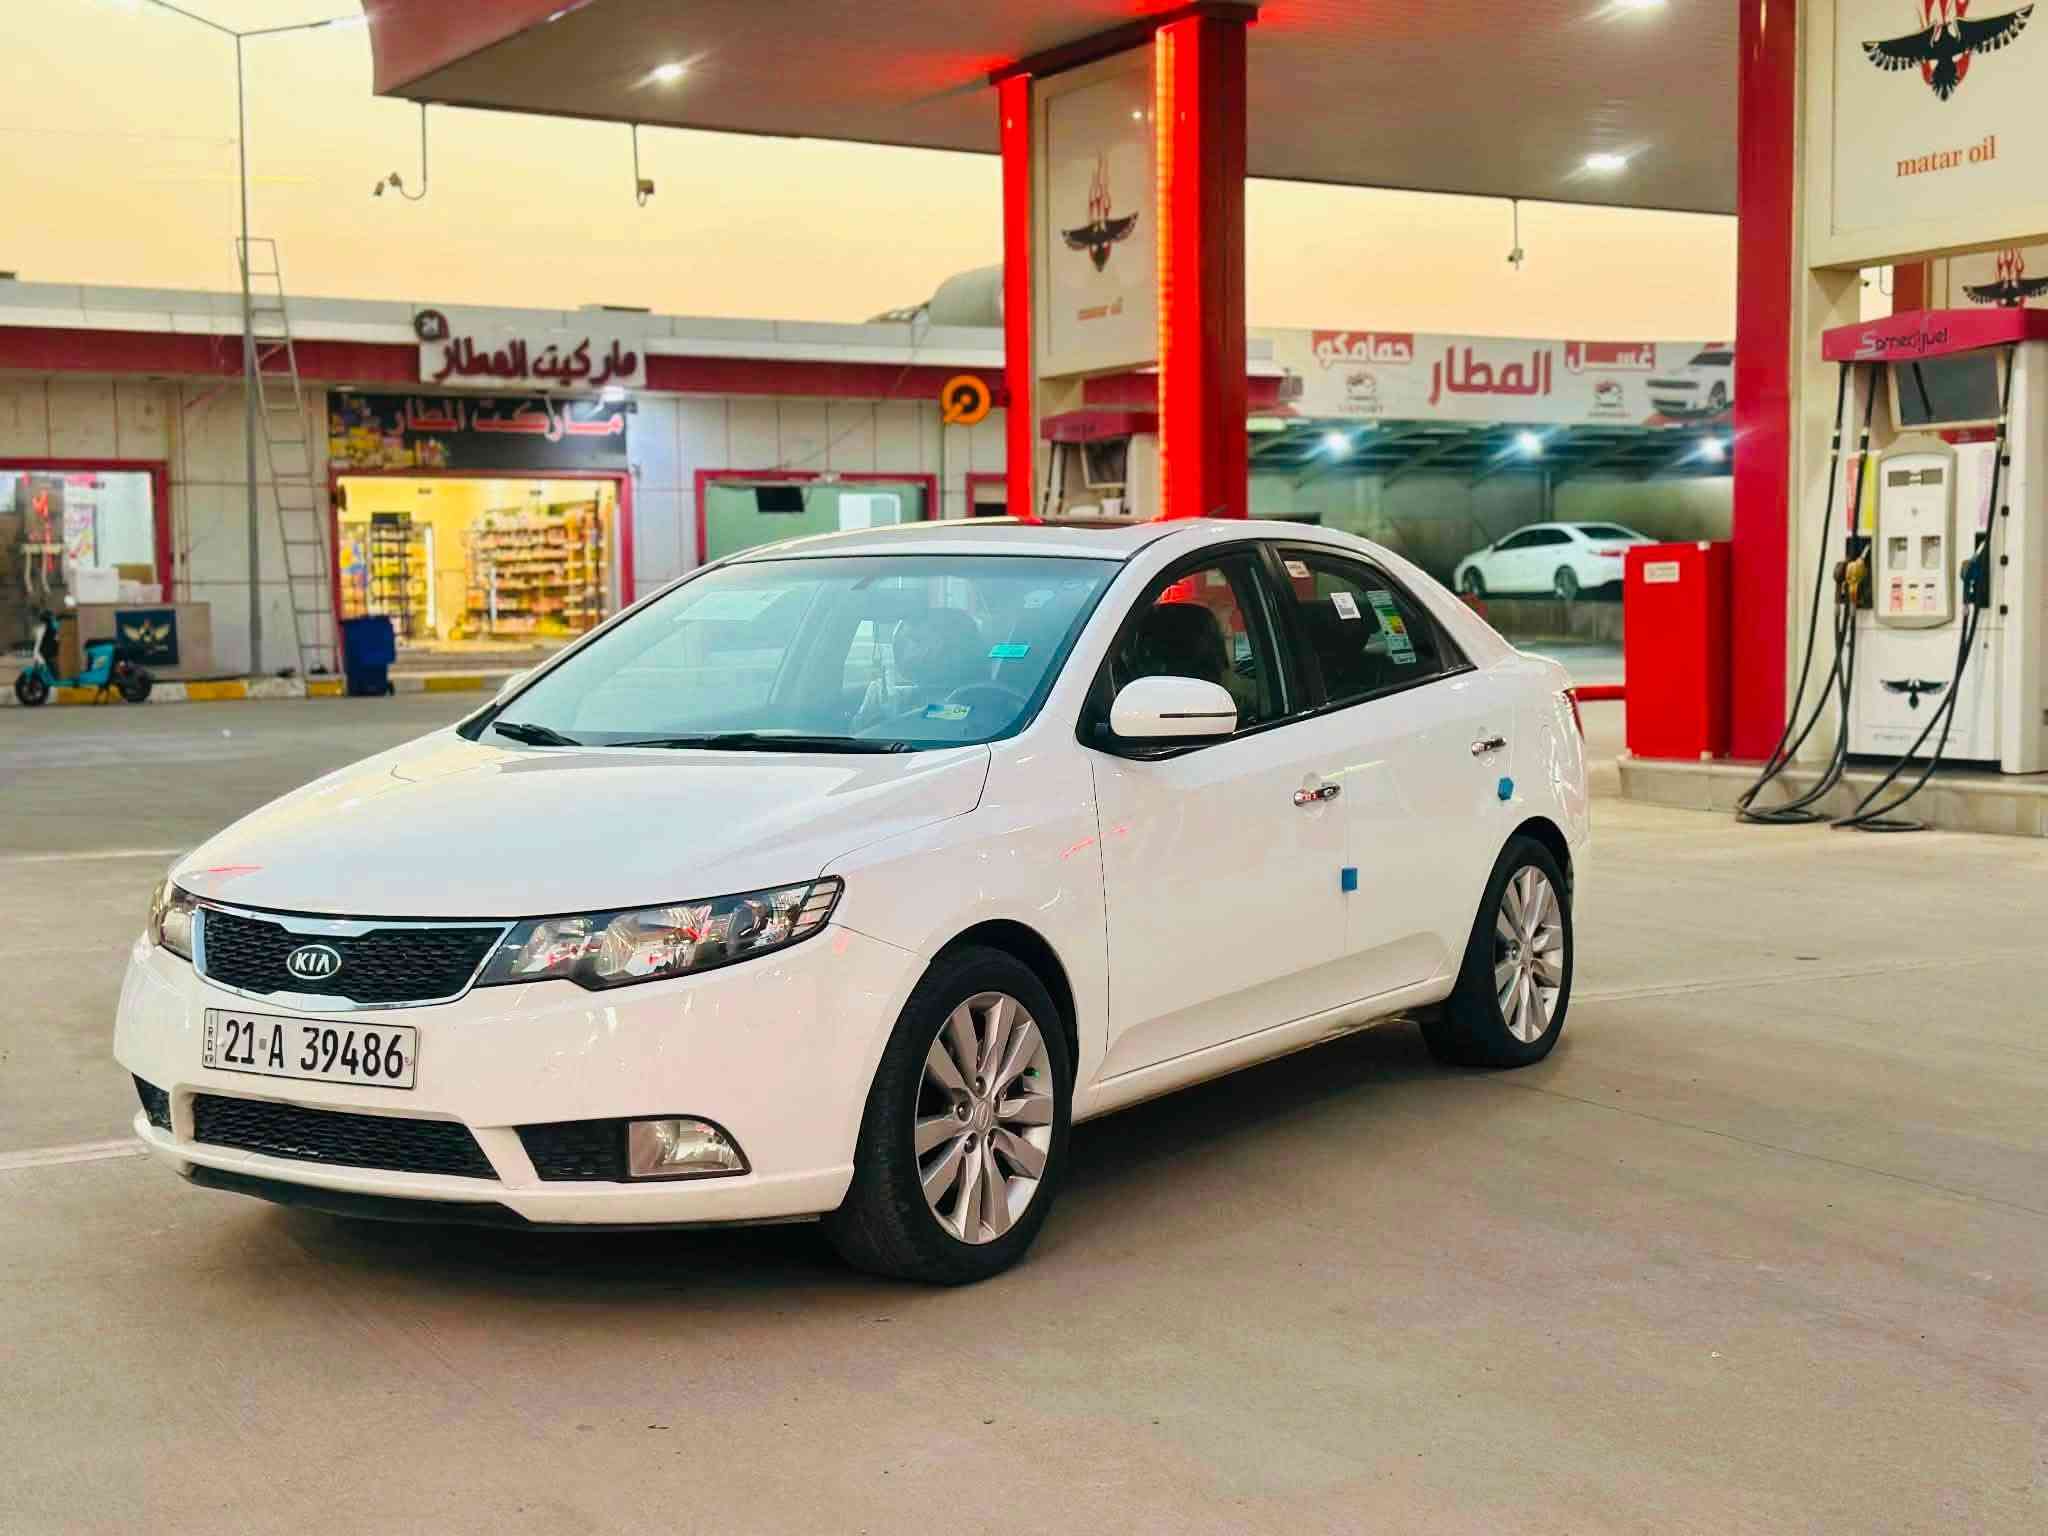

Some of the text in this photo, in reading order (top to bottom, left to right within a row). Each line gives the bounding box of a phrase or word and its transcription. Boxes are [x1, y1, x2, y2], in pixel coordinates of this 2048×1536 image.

[1896, 135, 1995, 177] matar oil
[433, 336, 637, 385] ماركيت المطار
[1428, 345, 1552, 404] المطار
[1567, 343, 1654, 374] غسل
[294, 953, 331, 973] KIA
[224, 1019, 404, 1078] 21 A 39486
